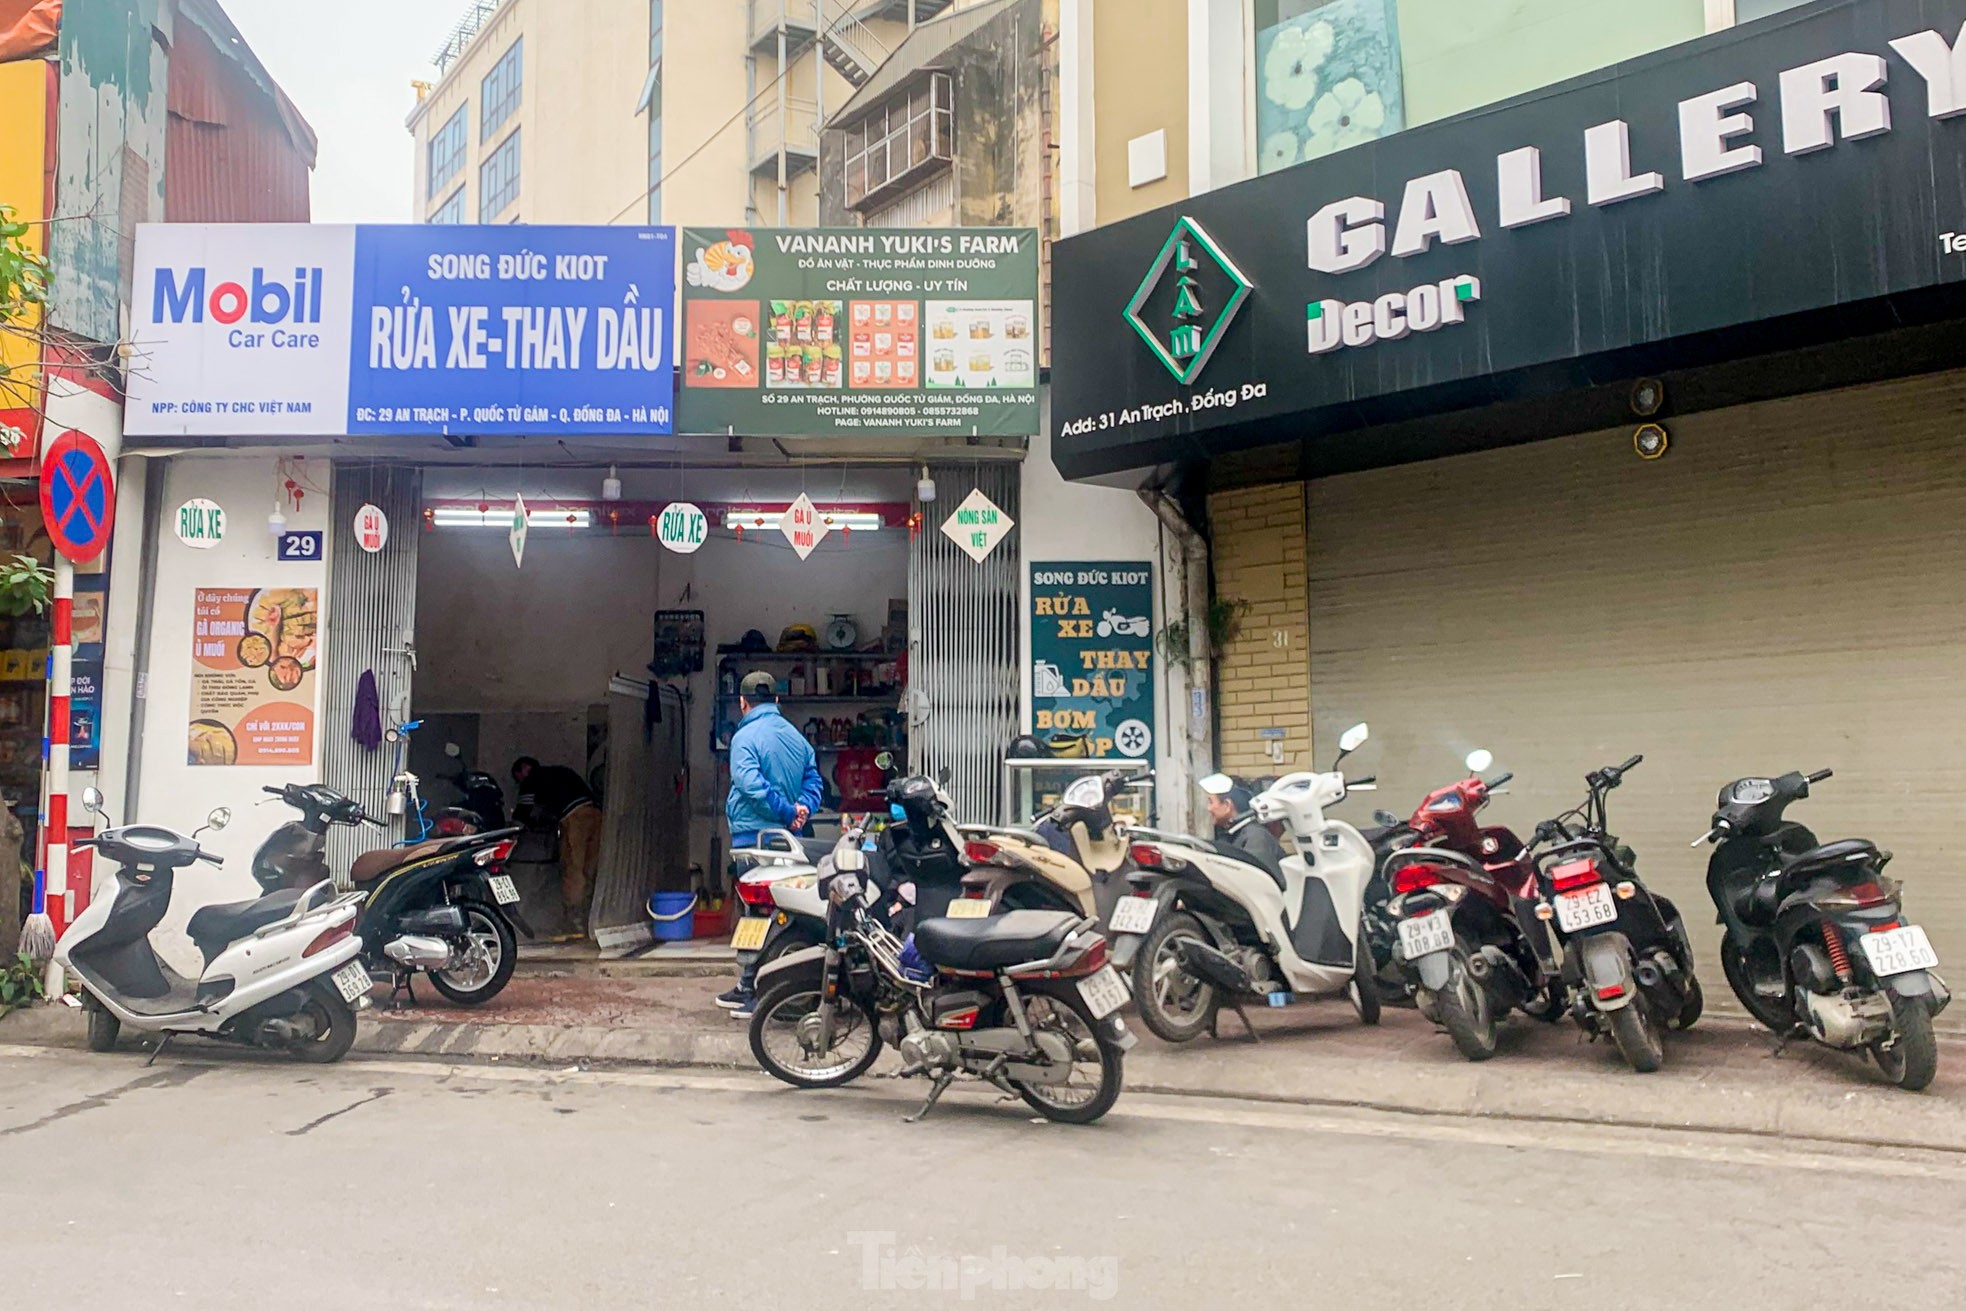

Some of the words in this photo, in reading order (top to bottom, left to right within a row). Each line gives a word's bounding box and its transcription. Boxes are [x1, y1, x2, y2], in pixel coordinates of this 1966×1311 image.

[1306, 19, 1966, 275] GALLERY
[775, 235, 874, 254] VANANH
[880, 235, 952, 254] YUKI'S
[959, 236, 1019, 254] FARM
[427, 254, 490, 279] SONG
[497, 249, 547, 279] ĐỨC
[555, 255, 608, 280] KIOT
[863, 259, 892, 271] THỰC
[894, 256, 925, 269] PHẨM
[928, 259, 955, 269] DINH
[152, 267, 323, 324] Mobil
[826, 277, 862, 292] CHẤT
[865, 279, 912, 295] LƯỢNG
[924, 280, 942, 292] UY
[946, 277, 968, 292] TÍN
[1307, 274, 1481, 355] Decor
[369, 285, 437, 370] RỬA
[445, 306, 587, 369] XE-THAY
[596, 284, 662, 371] DẦU
[228, 329, 264, 348] Car
[271, 329, 319, 348] Care
[152, 402, 178, 414] NPP:
[181, 400, 212, 414] CÔNG
[216, 402, 228, 413] TY
[232, 402, 255, 413] CHC
[259, 400, 283, 415] VIỆT
[286, 402, 312, 413] NAM
[762, 393, 776, 404] SỐ
[777, 395, 789, 403] 29
[790, 395, 804, 403] AN
[883, 393, 911, 404] QUỐC
[1003, 393, 1016, 403] HÀ
[1018, 394, 1035, 405] NỘI
[1061, 417, 1096, 437] Add:
[1098, 412, 1115, 429] 31
[1191, 387, 1237, 411] Đống
[1241, 381, 1266, 400] Đa
[356, 407, 375, 422] ĐC:
[378, 408, 393, 422] 29
[395, 408, 410, 422] AN
[413, 408, 448, 424] TRẠCH
[460, 408, 470, 422] P.
[473, 404, 504, 422] QUỐC
[506, 404, 521, 422] TỬ
[559, 408, 571, 422] Q.
[573, 403, 603, 422] ĐỐNG
[606, 408, 622, 422] ĐA
[632, 404, 647, 422] HÀ
[650, 406, 669, 425] NỘI
[817, 407, 859, 415] HOTLINE:
[835, 418, 861, 427] PAGE:
[862, 418, 902, 427] VANANH
[904, 418, 934, 427] YUKI'S
[936, 418, 961, 427] FARM
[181, 500, 204, 538] RỬA
[207, 508, 222, 539] XE
[662, 504, 684, 542] RỬA
[688, 513, 704, 543] XE
[285, 535, 316, 556] 29
[1034, 571, 1073, 585] SONG
[1077, 569, 1108, 585] ĐỨC
[1112, 572, 1148, 585] KIOT
[1035, 591, 1090, 615] RỬA
[1057, 620, 1093, 637] XE
[1080, 651, 1150, 669] THAY
[1072, 671, 1125, 697] DẦU
[1036, 709, 1096, 729] BƠM
[1565, 906, 1612, 928] 453.68
